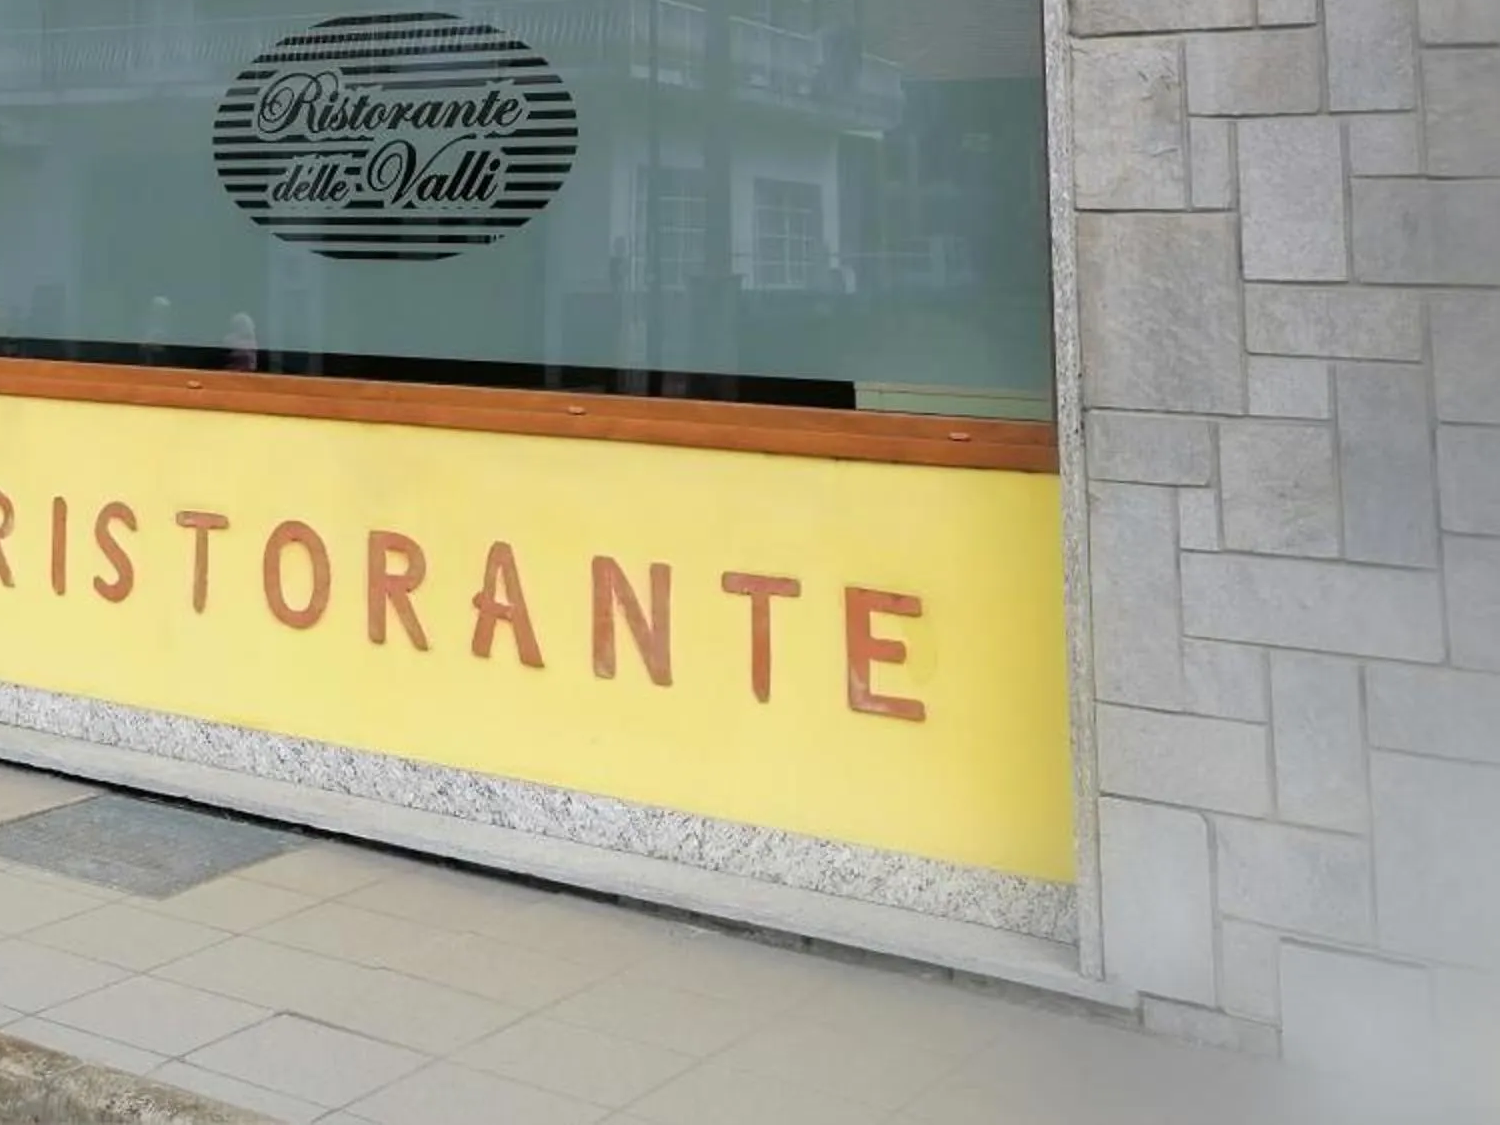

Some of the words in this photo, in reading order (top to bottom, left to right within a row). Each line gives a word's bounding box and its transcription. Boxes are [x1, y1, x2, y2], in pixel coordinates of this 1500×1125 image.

[257, 71, 523, 133] Ristorante
[273, 164, 350, 202] delle
[366, 134, 500, 203] Valli
